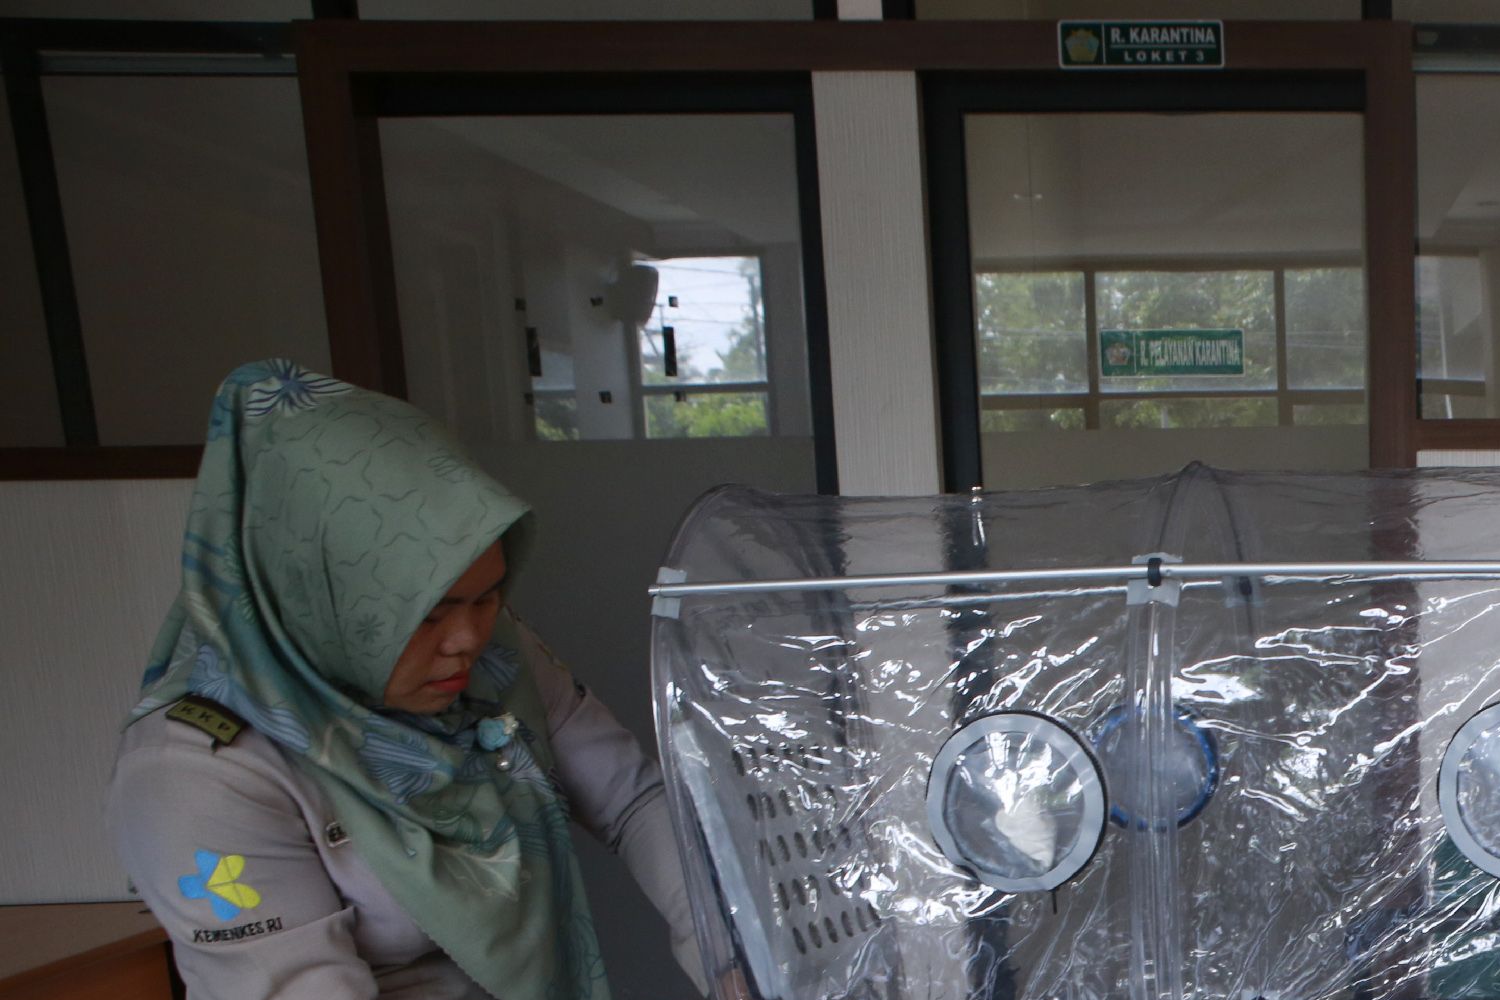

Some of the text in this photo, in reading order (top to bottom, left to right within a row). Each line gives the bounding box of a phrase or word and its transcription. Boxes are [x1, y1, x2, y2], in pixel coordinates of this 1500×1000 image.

[1110, 27, 1215, 43] R. KARANTINA
[1124, 51, 1204, 61] LOKET 3
[1196, 339, 1240, 366] KARANTINA
[193, 917, 283, 943] KEMENKES RI
